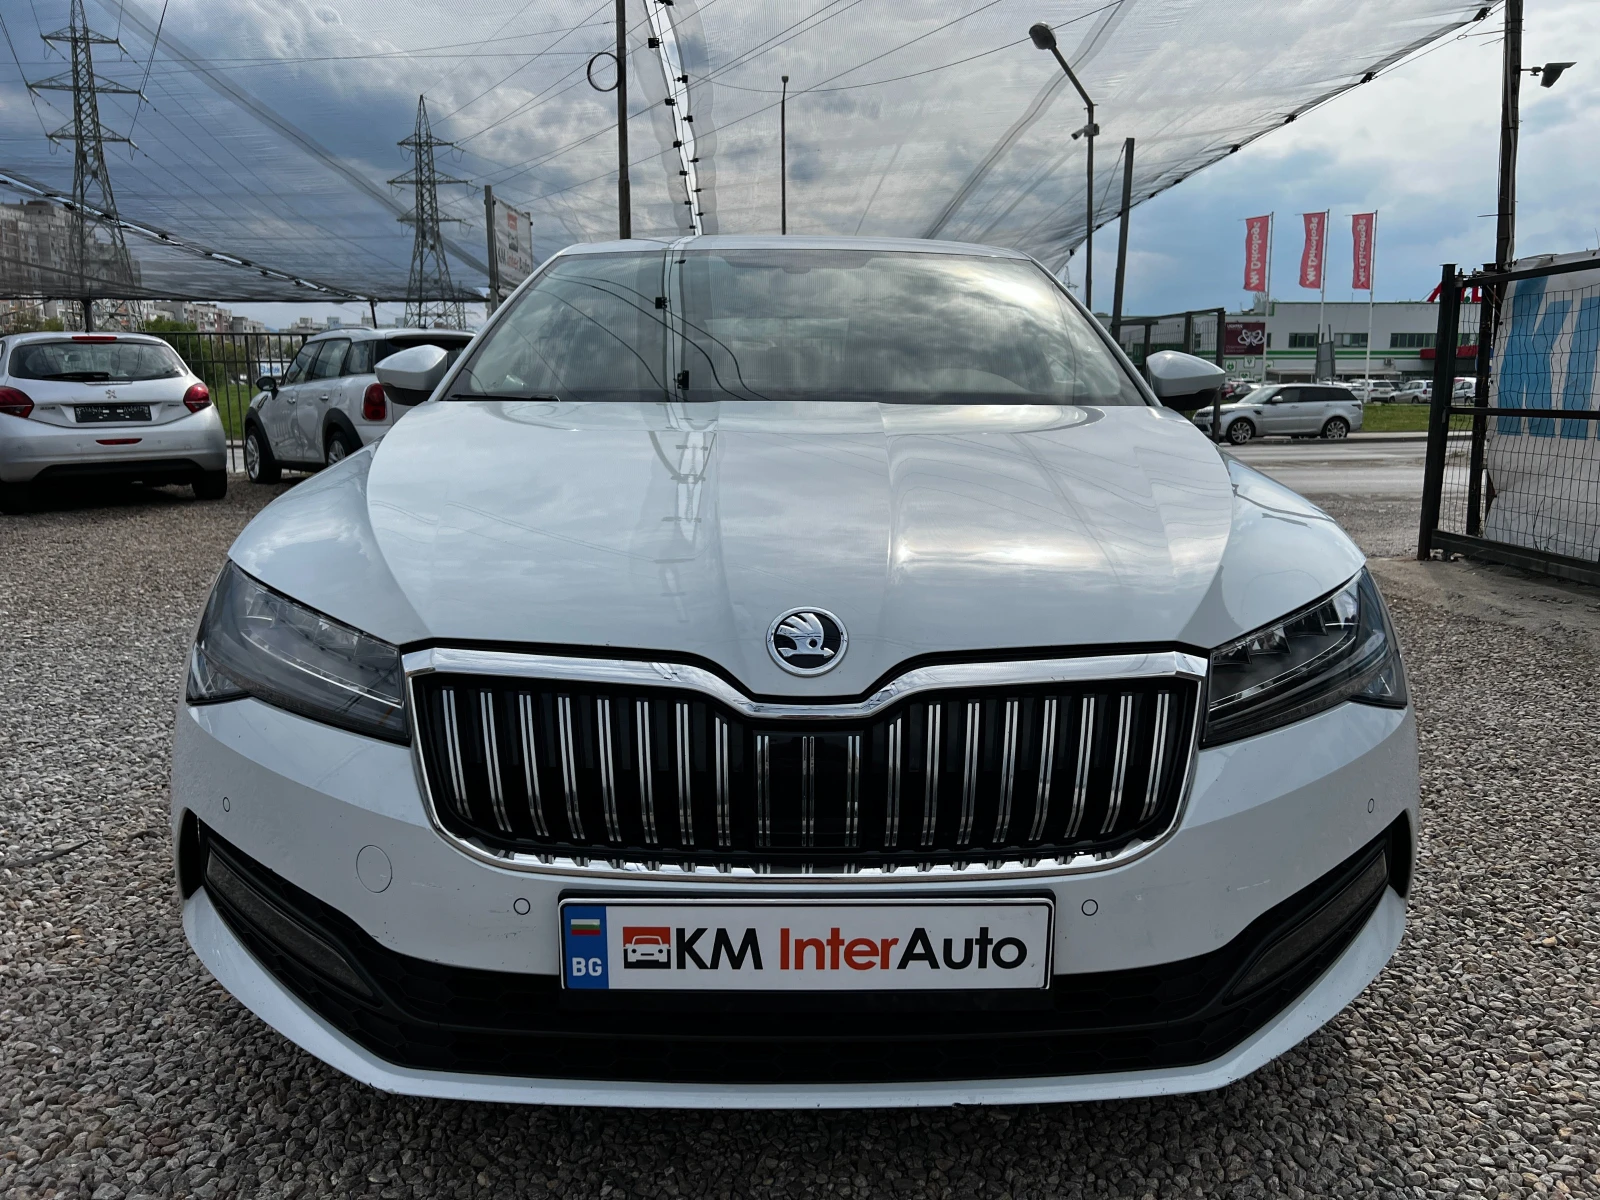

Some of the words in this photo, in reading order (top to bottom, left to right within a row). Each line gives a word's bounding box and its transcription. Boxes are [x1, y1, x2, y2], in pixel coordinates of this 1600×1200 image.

[676, 927, 763, 970] KM
[780, 926, 1028, 971] InterAuto
[572, 957, 602, 977] BG
